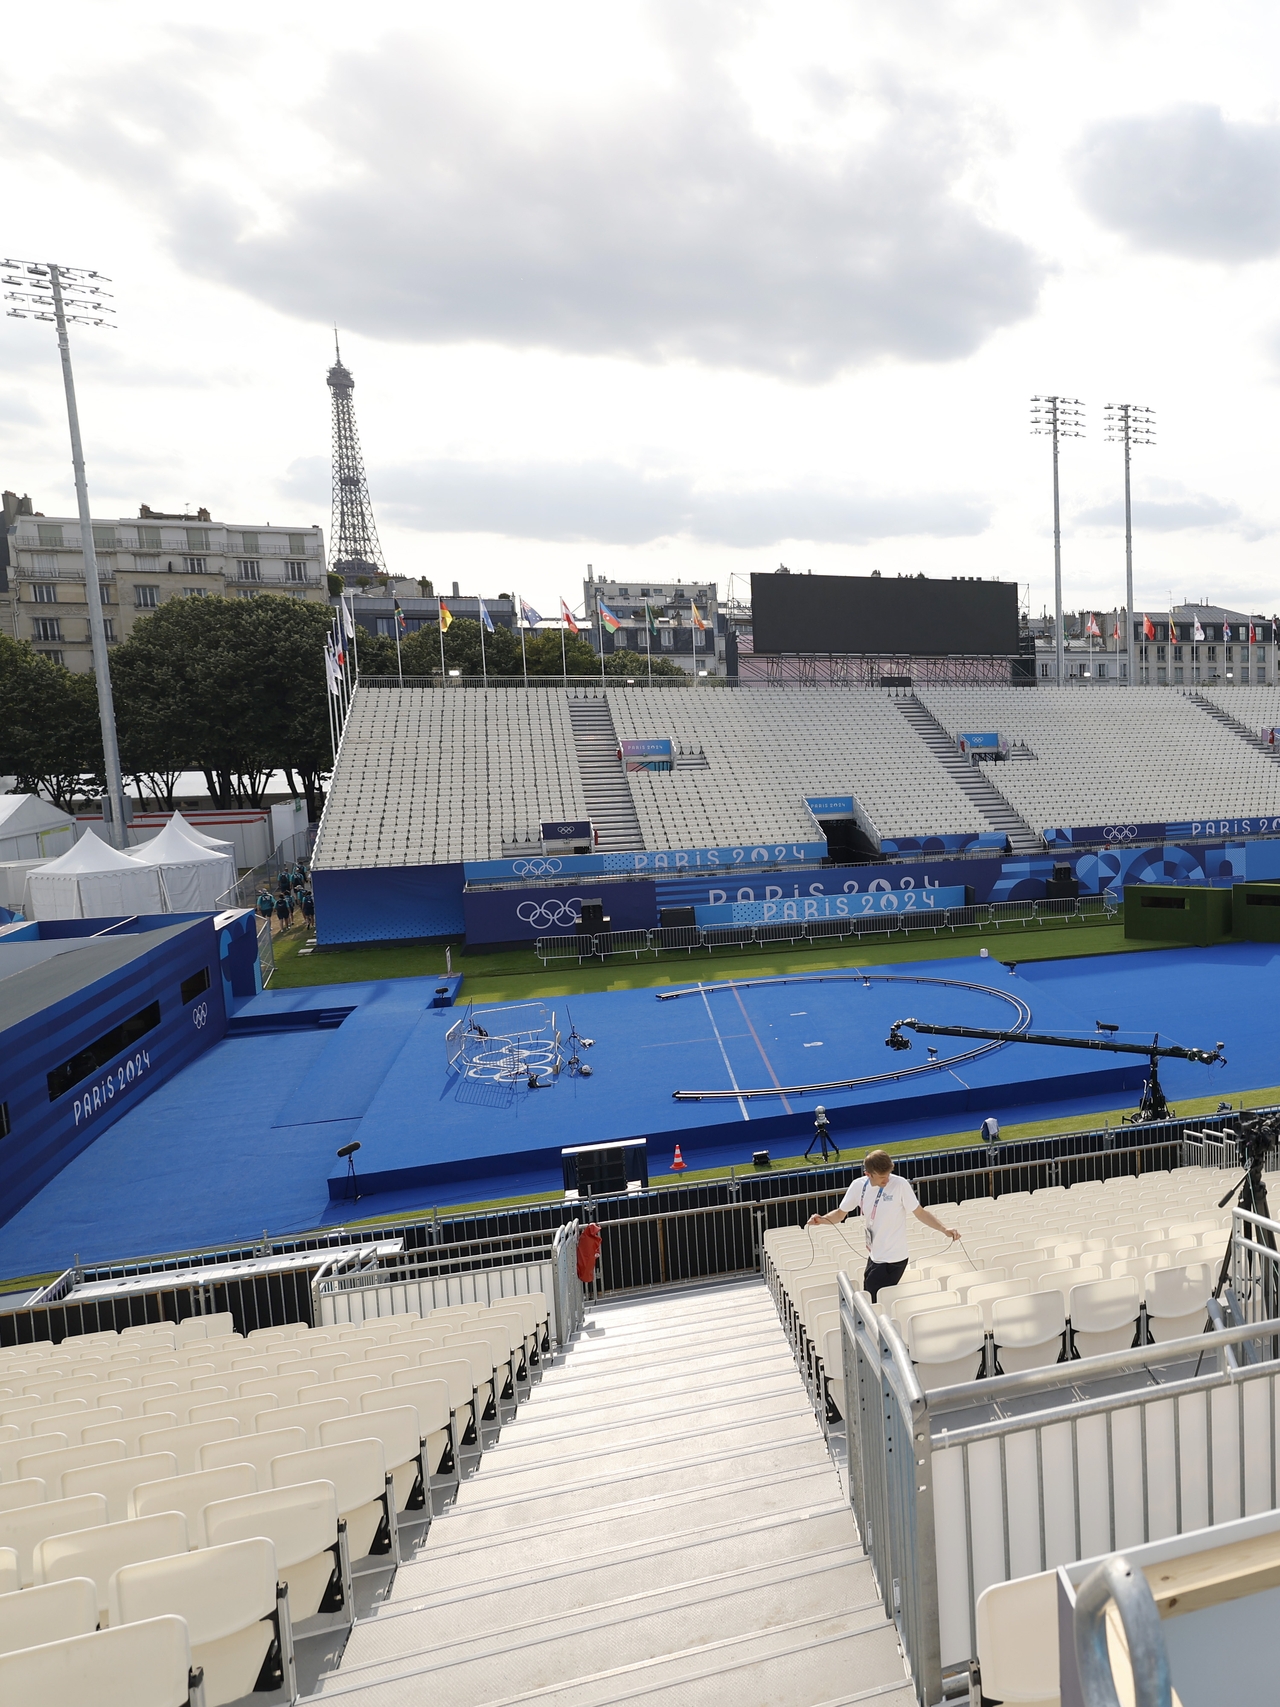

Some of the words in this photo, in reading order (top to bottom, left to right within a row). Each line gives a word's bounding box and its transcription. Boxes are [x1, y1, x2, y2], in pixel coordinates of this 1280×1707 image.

[732, 845, 805, 866] 2024
[861, 891, 935, 914] 2024
[117, 1049, 150, 1091] 2024
